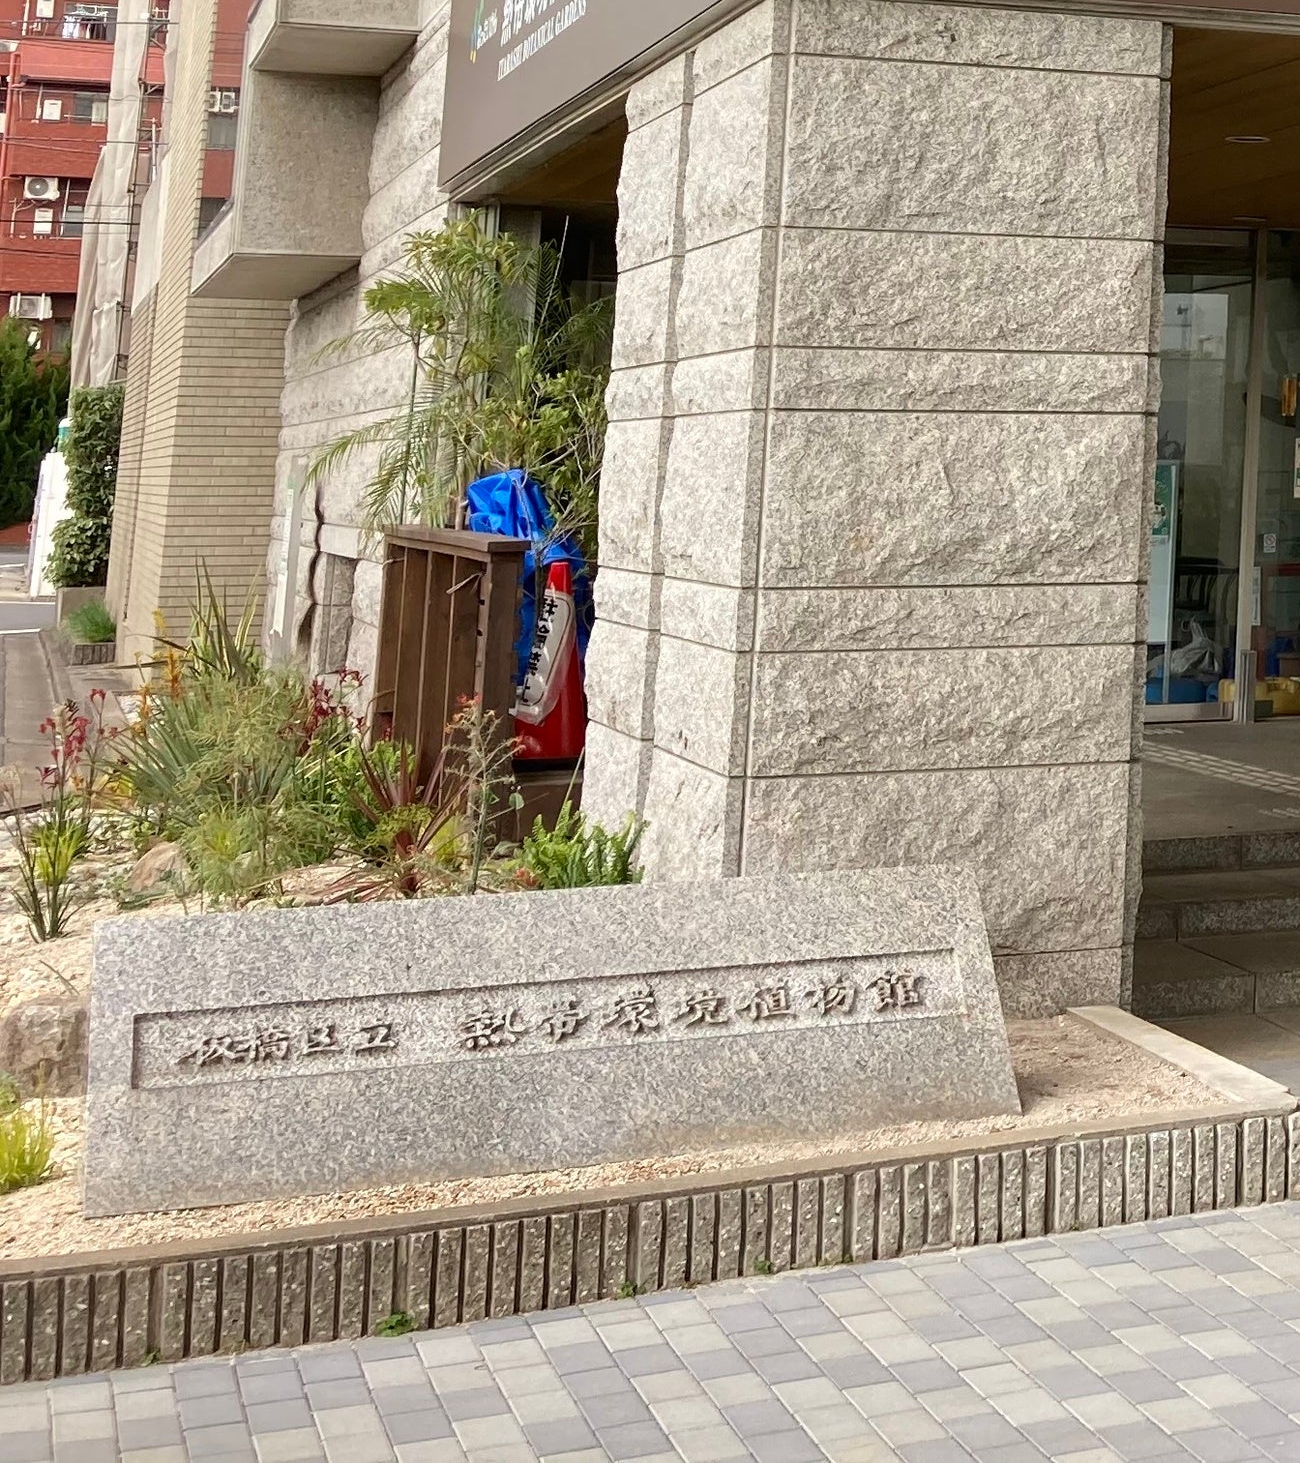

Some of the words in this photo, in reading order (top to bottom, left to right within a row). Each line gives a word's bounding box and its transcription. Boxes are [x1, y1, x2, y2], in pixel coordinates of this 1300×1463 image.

[176, 1019, 399, 1067] 板橋区立
[453, 968, 928, 1053] 熱帯環境植物館
